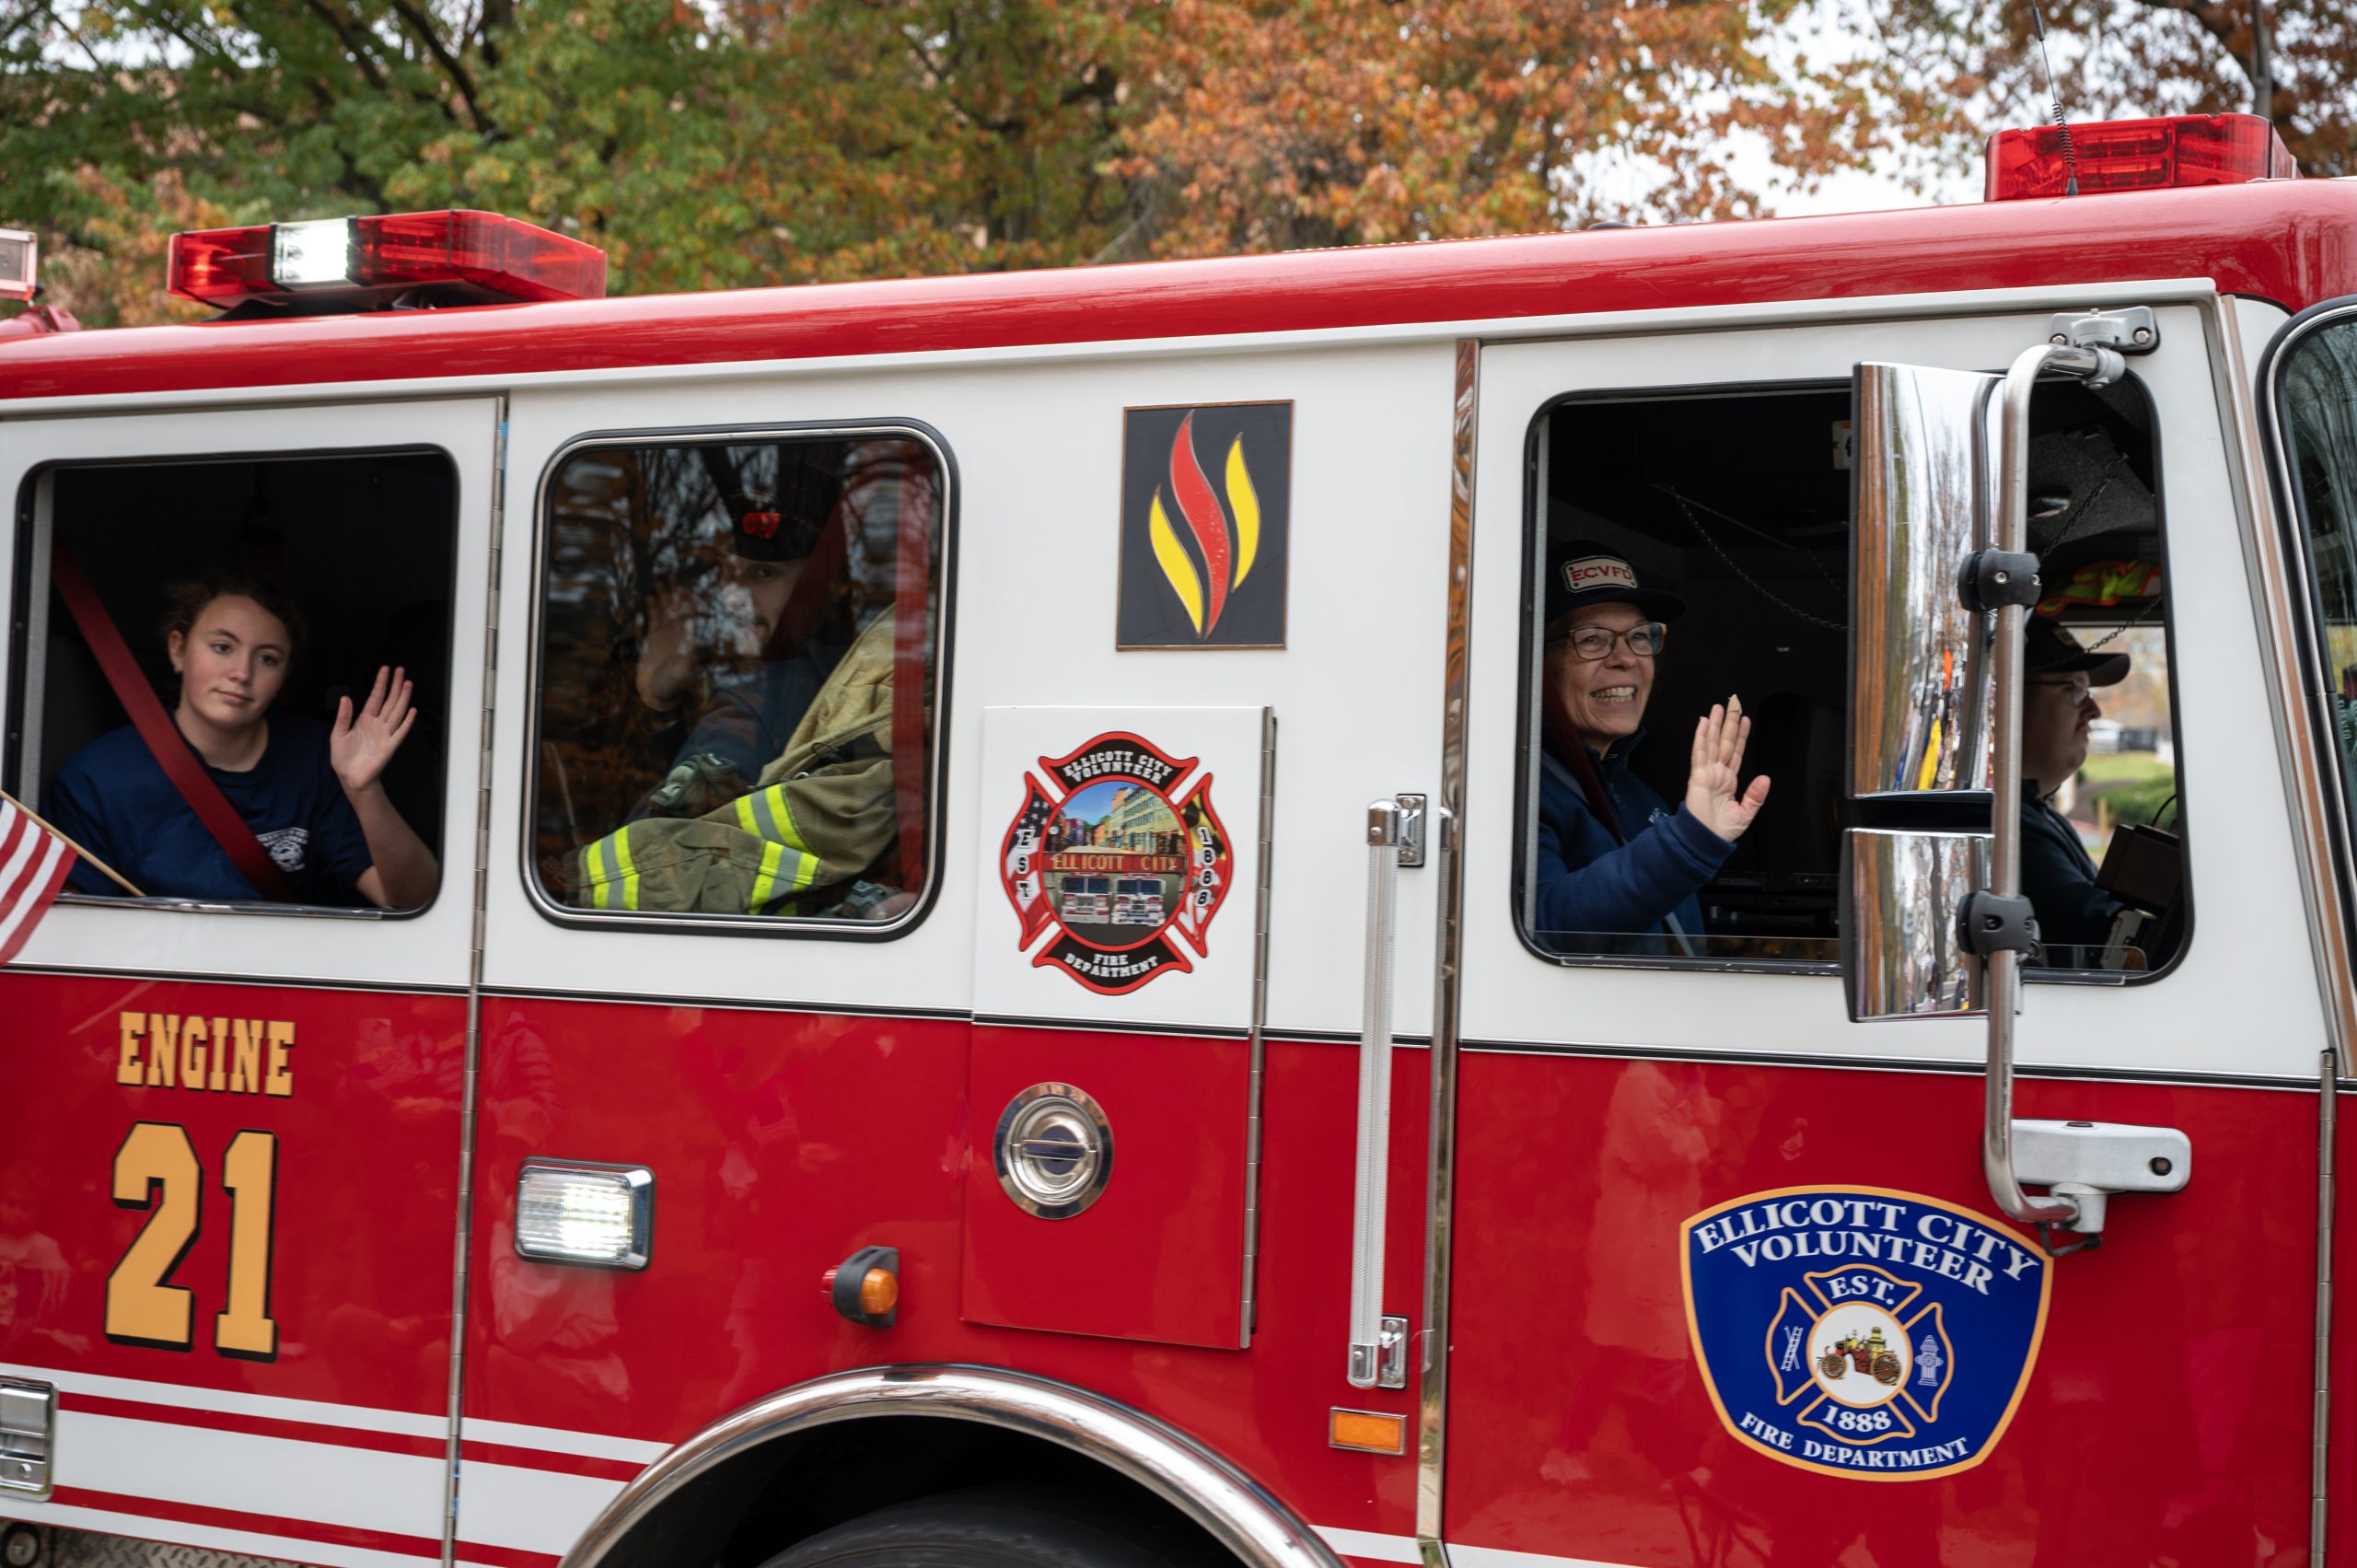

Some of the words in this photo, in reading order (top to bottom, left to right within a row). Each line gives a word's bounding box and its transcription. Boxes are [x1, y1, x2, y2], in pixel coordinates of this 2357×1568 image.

[1571, 565, 1632, 582] ECVFD
[1062, 750, 1134, 777] ELLICOTT
[1138, 754, 1173, 777] CITY
[1071, 761, 1167, 784] VOLUNTEER
[1016, 829, 1035, 901] EST
[1051, 853, 1125, 870] ELLICOTT
[1140, 854, 1178, 872] CITY
[1195, 826, 1216, 907] 1888
[1063, 953, 1159, 978] DEPARTMENT
[1093, 954, 1129, 966] FIRE
[117, 1011, 296, 1097] ENGINE
[104, 1120, 279, 1364] 21
[1694, 1199, 1907, 1255] ELLICOTT
[1917, 1214, 2040, 1282] CITY
[1730, 1230, 1994, 1295] VOLUNTEER
[1827, 1274, 1896, 1306] EST.
[1821, 1405, 1892, 1433] 1888
[1738, 1412, 1794, 1450] FIRE
[1803, 1437, 1970, 1469] DEPARTMENT
